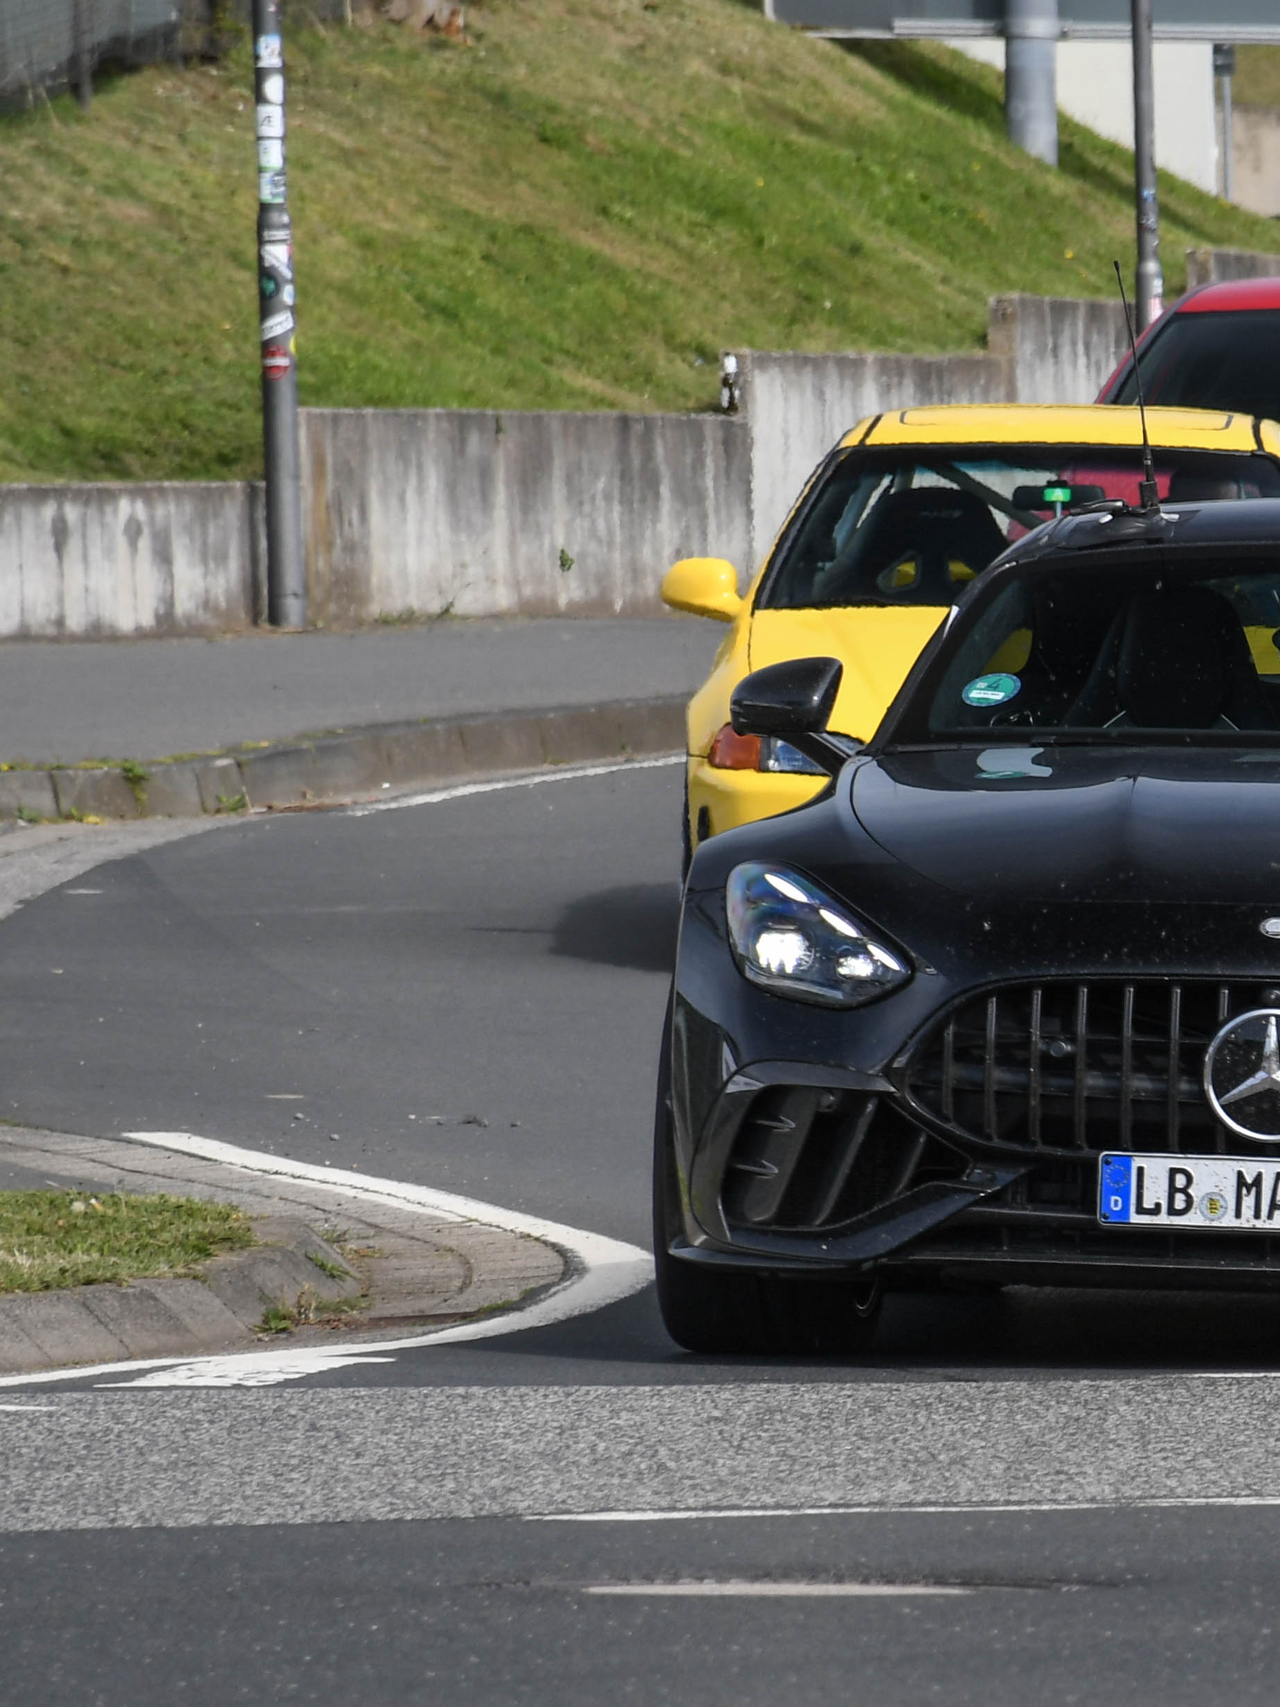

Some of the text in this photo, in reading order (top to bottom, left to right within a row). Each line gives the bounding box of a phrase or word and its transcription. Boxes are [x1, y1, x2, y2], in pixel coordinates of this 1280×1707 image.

[987, 678, 1003, 691] 4
[1135, 1165, 1194, 1216] LB
[1111, 1196, 1122, 1210] D
